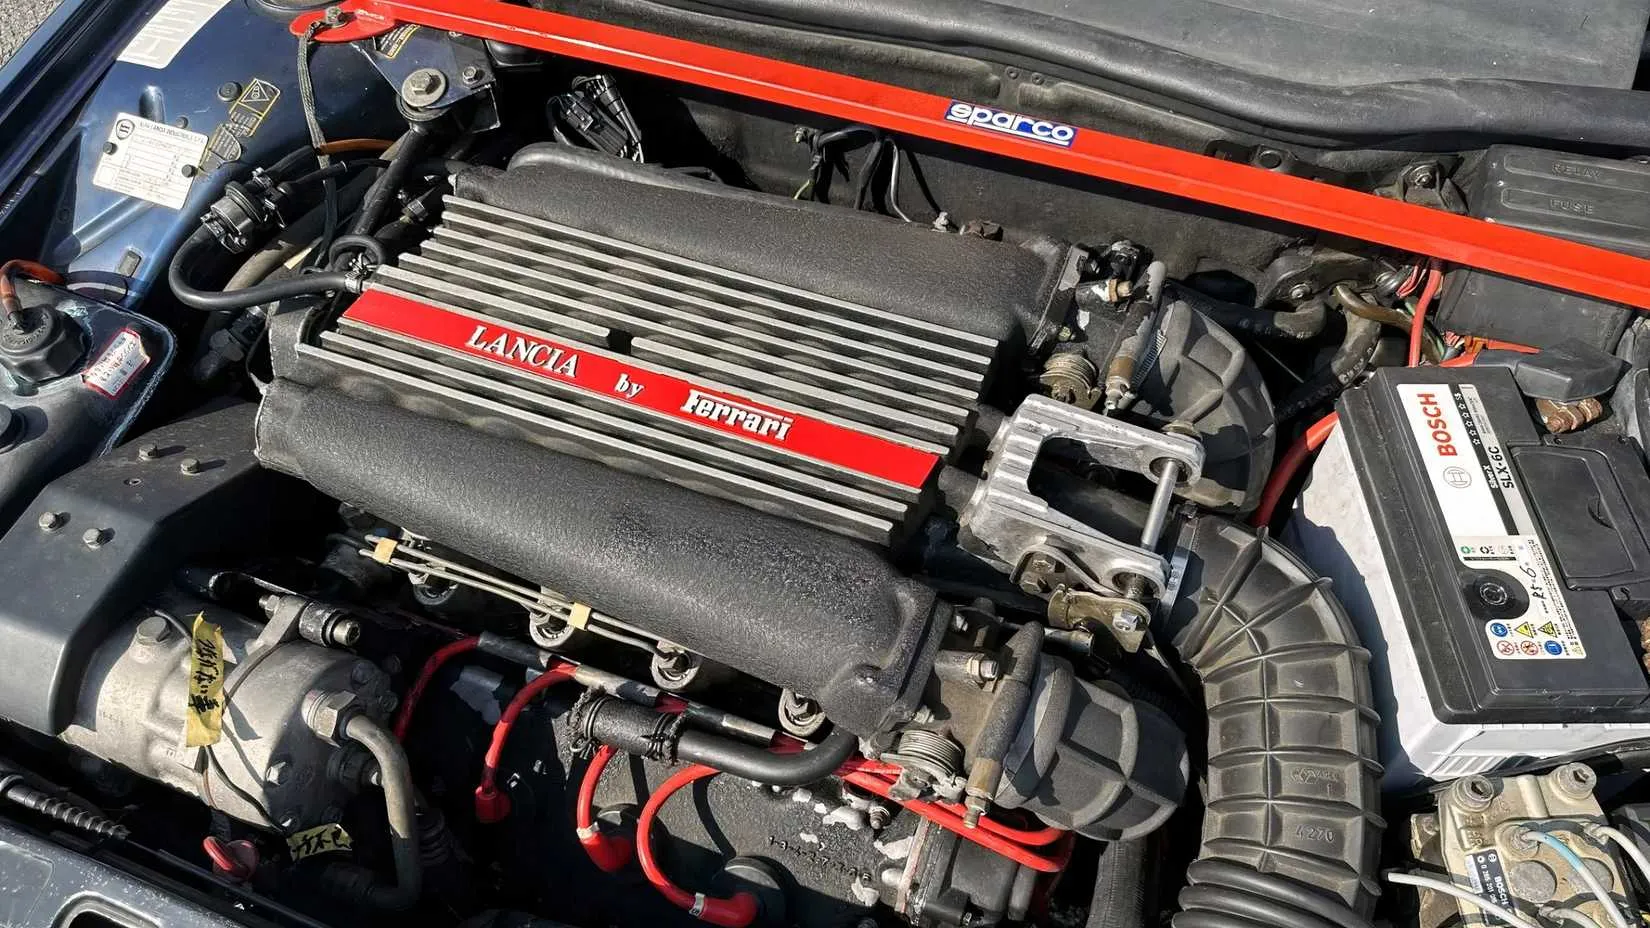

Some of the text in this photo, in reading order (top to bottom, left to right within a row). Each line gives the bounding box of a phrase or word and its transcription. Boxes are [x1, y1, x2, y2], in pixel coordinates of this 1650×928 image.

[949, 103, 1074, 141] sparco
[1551, 163, 1601, 180] RELAY
[1550, 199, 1594, 216] FUSE
[464, 325, 794, 441] LANCIA by Ferrari
[1417, 393, 1459, 456] BOSCH
[1486, 472, 1499, 489] Silver
[1488, 446, 1515, 489] SLX-6C
[1494, 876, 1509, 905] BOSCH
